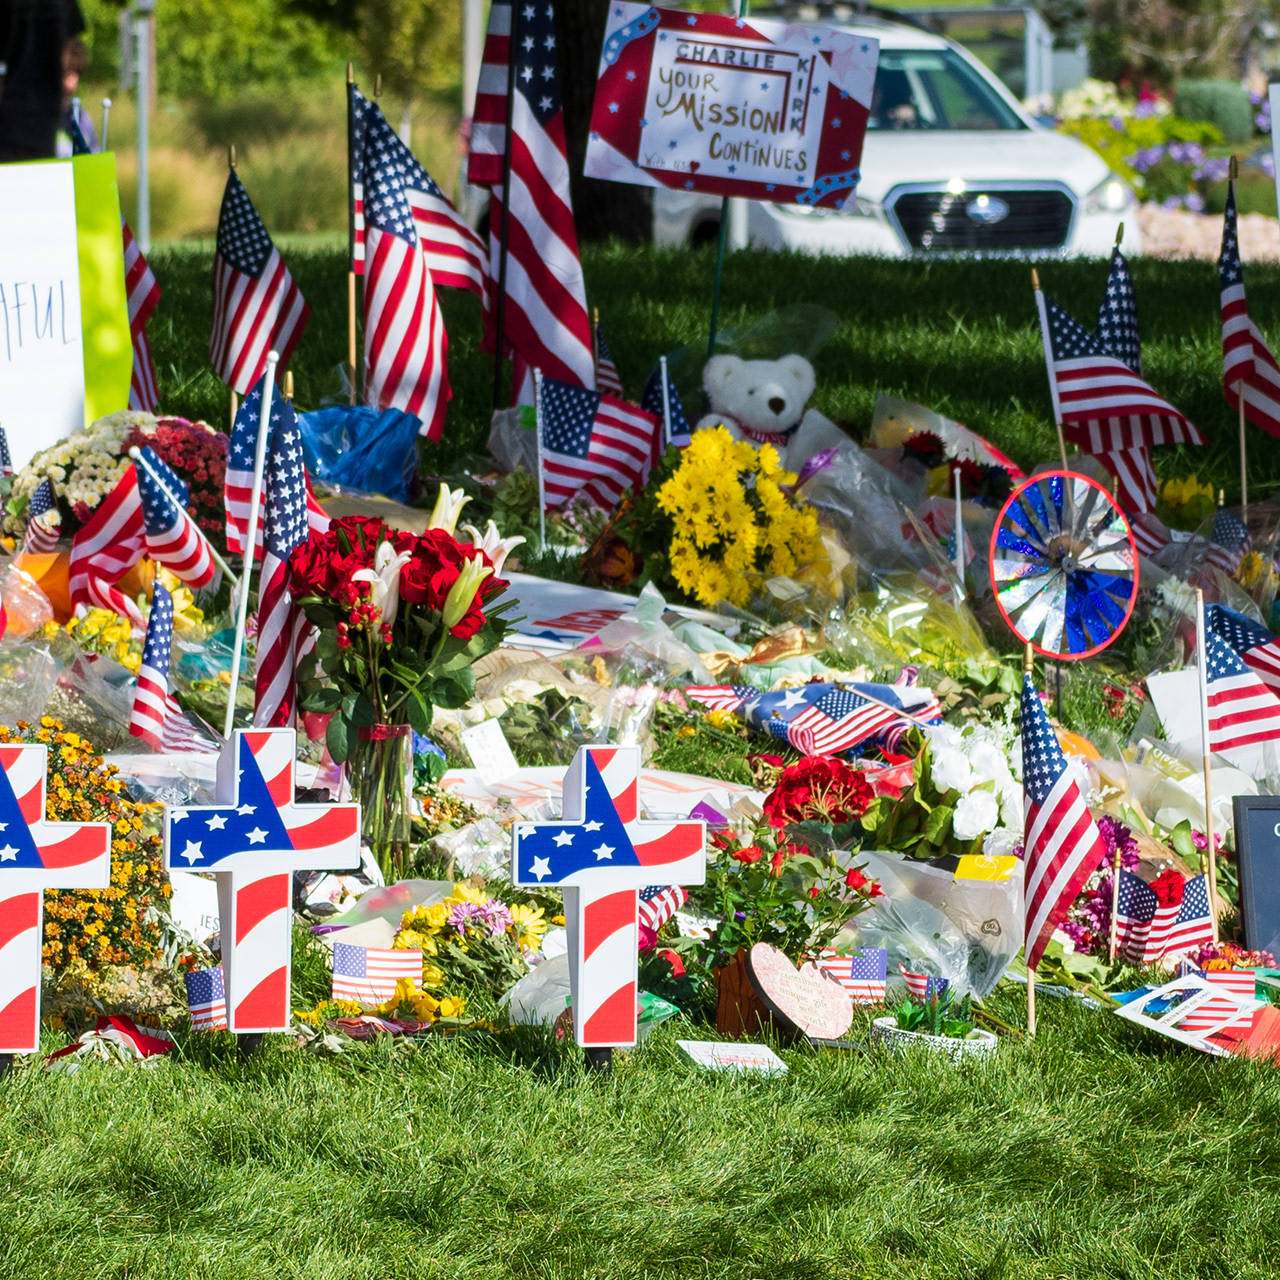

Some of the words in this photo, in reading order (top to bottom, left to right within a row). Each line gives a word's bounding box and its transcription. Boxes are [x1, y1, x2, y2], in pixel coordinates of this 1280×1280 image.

[676, 43, 776, 69] CHARLIE
[790, 57, 811, 132] KIRK
[802, 1014, 828, 1029] world
[1160, 1005, 1190, 1026] THINKING
